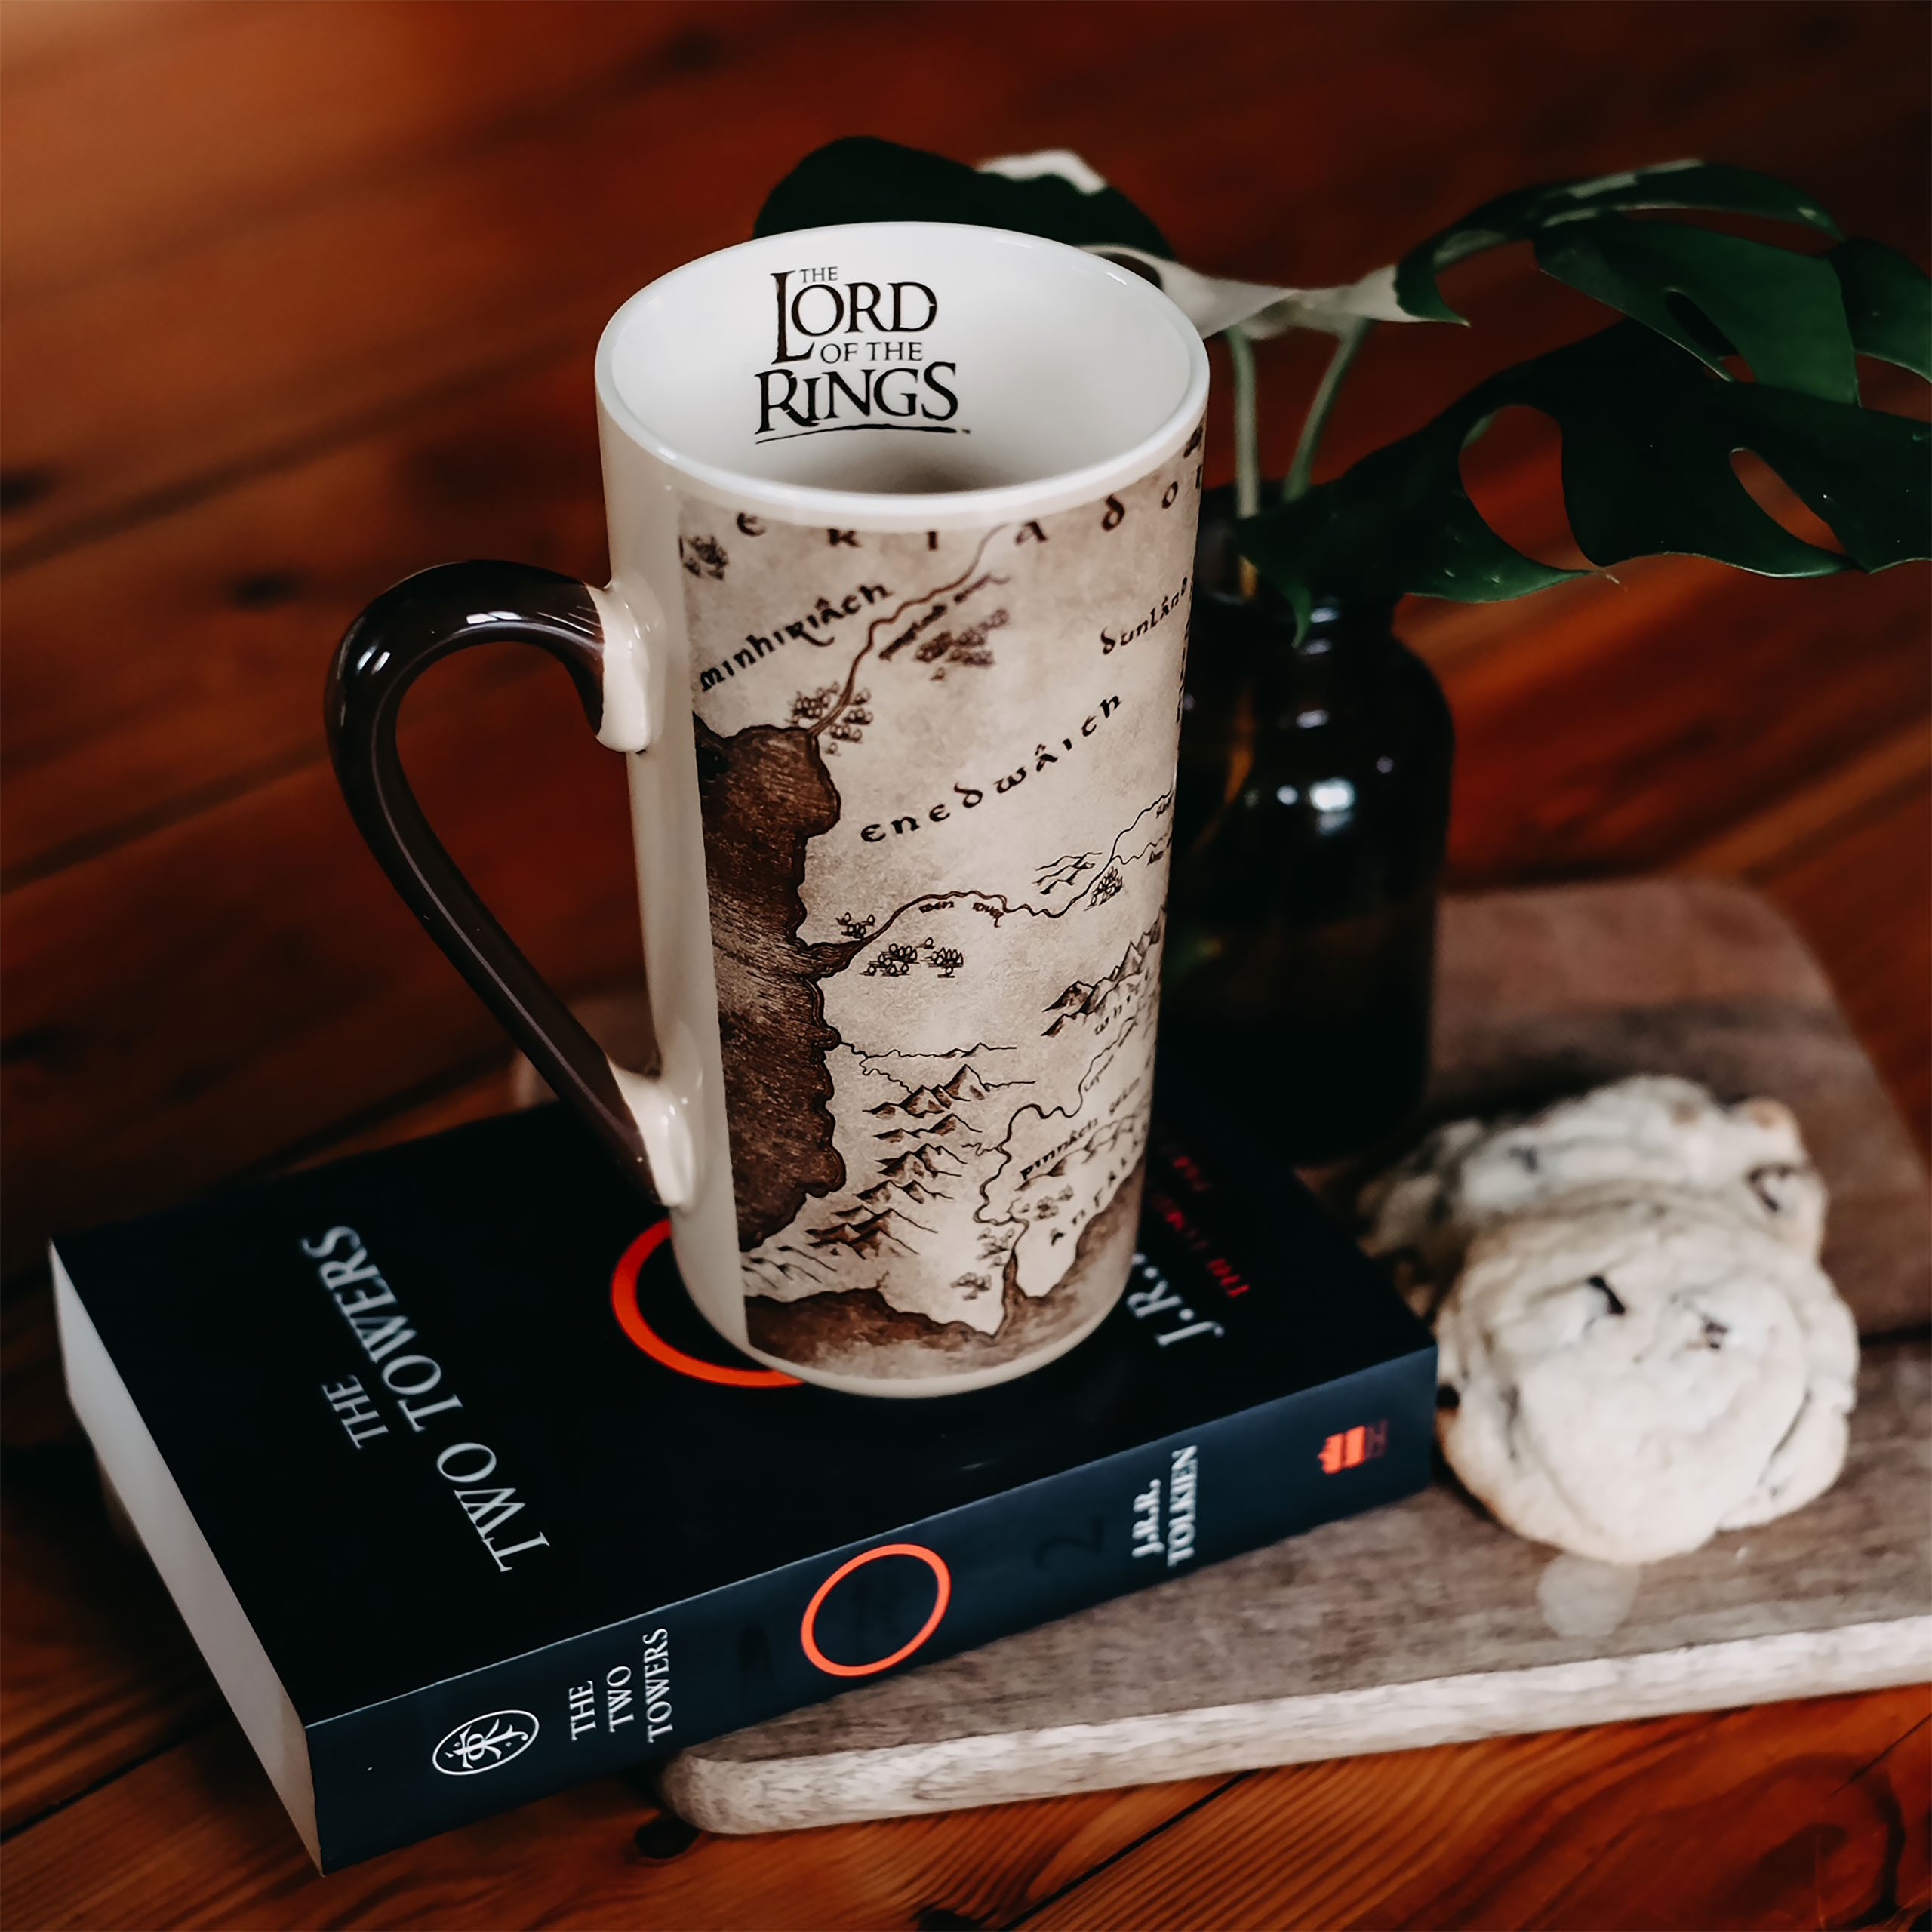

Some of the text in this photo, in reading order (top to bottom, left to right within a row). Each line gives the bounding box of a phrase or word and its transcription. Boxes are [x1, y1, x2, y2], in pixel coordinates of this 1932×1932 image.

[800, 266, 838, 283] THE
[771, 270, 938, 365] LORD
[820, 341, 923, 364] OF THE
[754, 361, 958, 435] RINGS
[300, 1225, 551, 1573] TWO TOWERS
[321, 1374, 389, 1450] THE
[1131, 1478, 1166, 1558] J.R.R.
[1167, 1445, 1198, 1567] TOLKIEN
[568, 1680, 597, 1741] THE
[606, 1665, 635, 1733] TWO
[642, 1627, 673, 1743] TOWERS
